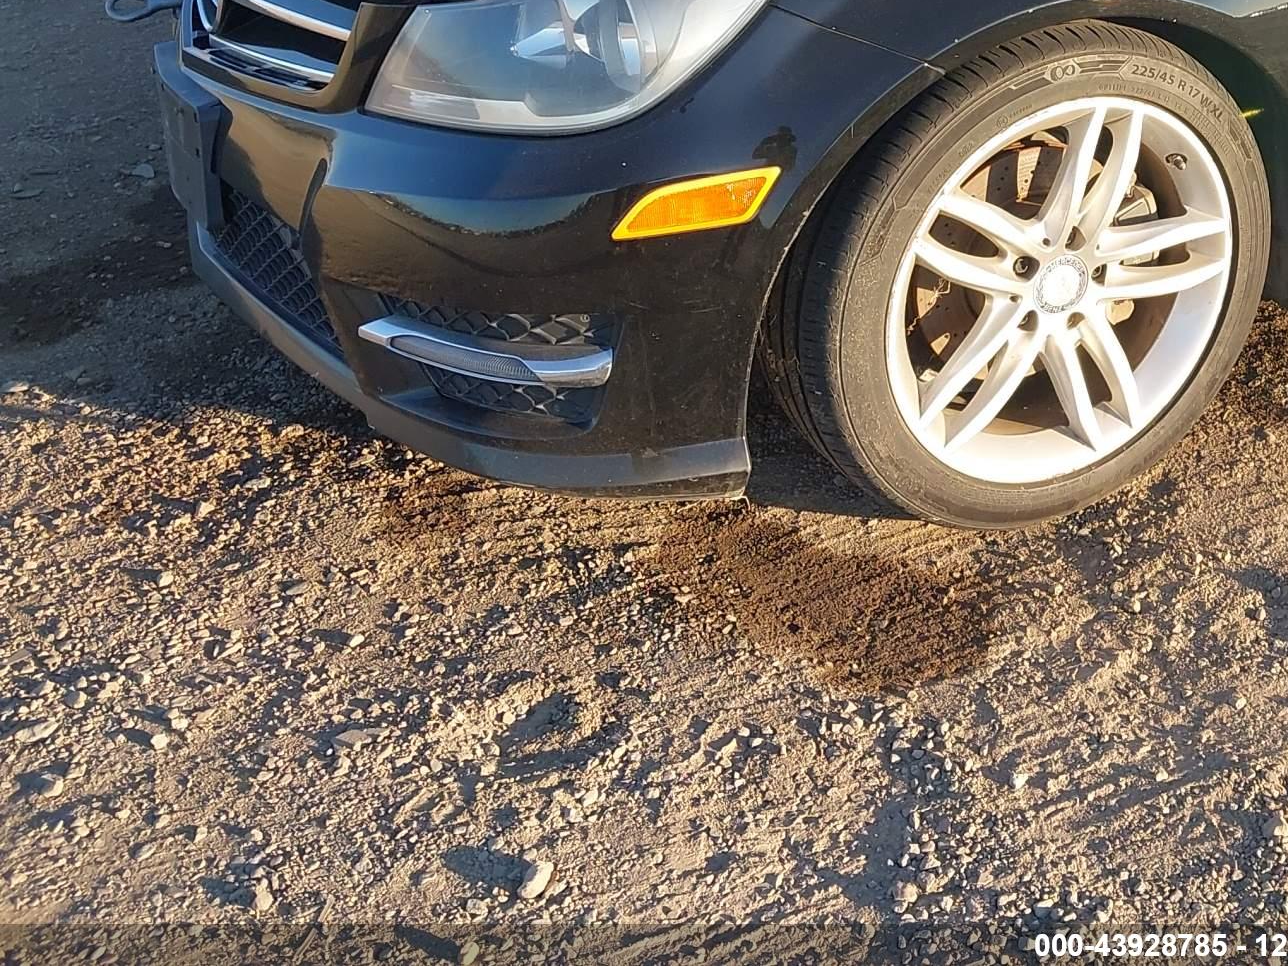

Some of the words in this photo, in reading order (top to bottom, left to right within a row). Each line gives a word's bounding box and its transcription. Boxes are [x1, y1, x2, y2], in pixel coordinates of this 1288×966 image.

[1131, 63, 1176, 86] 225/45
[1177, 79, 1187, 92] R
[1187, 85, 1201, 99] 17
